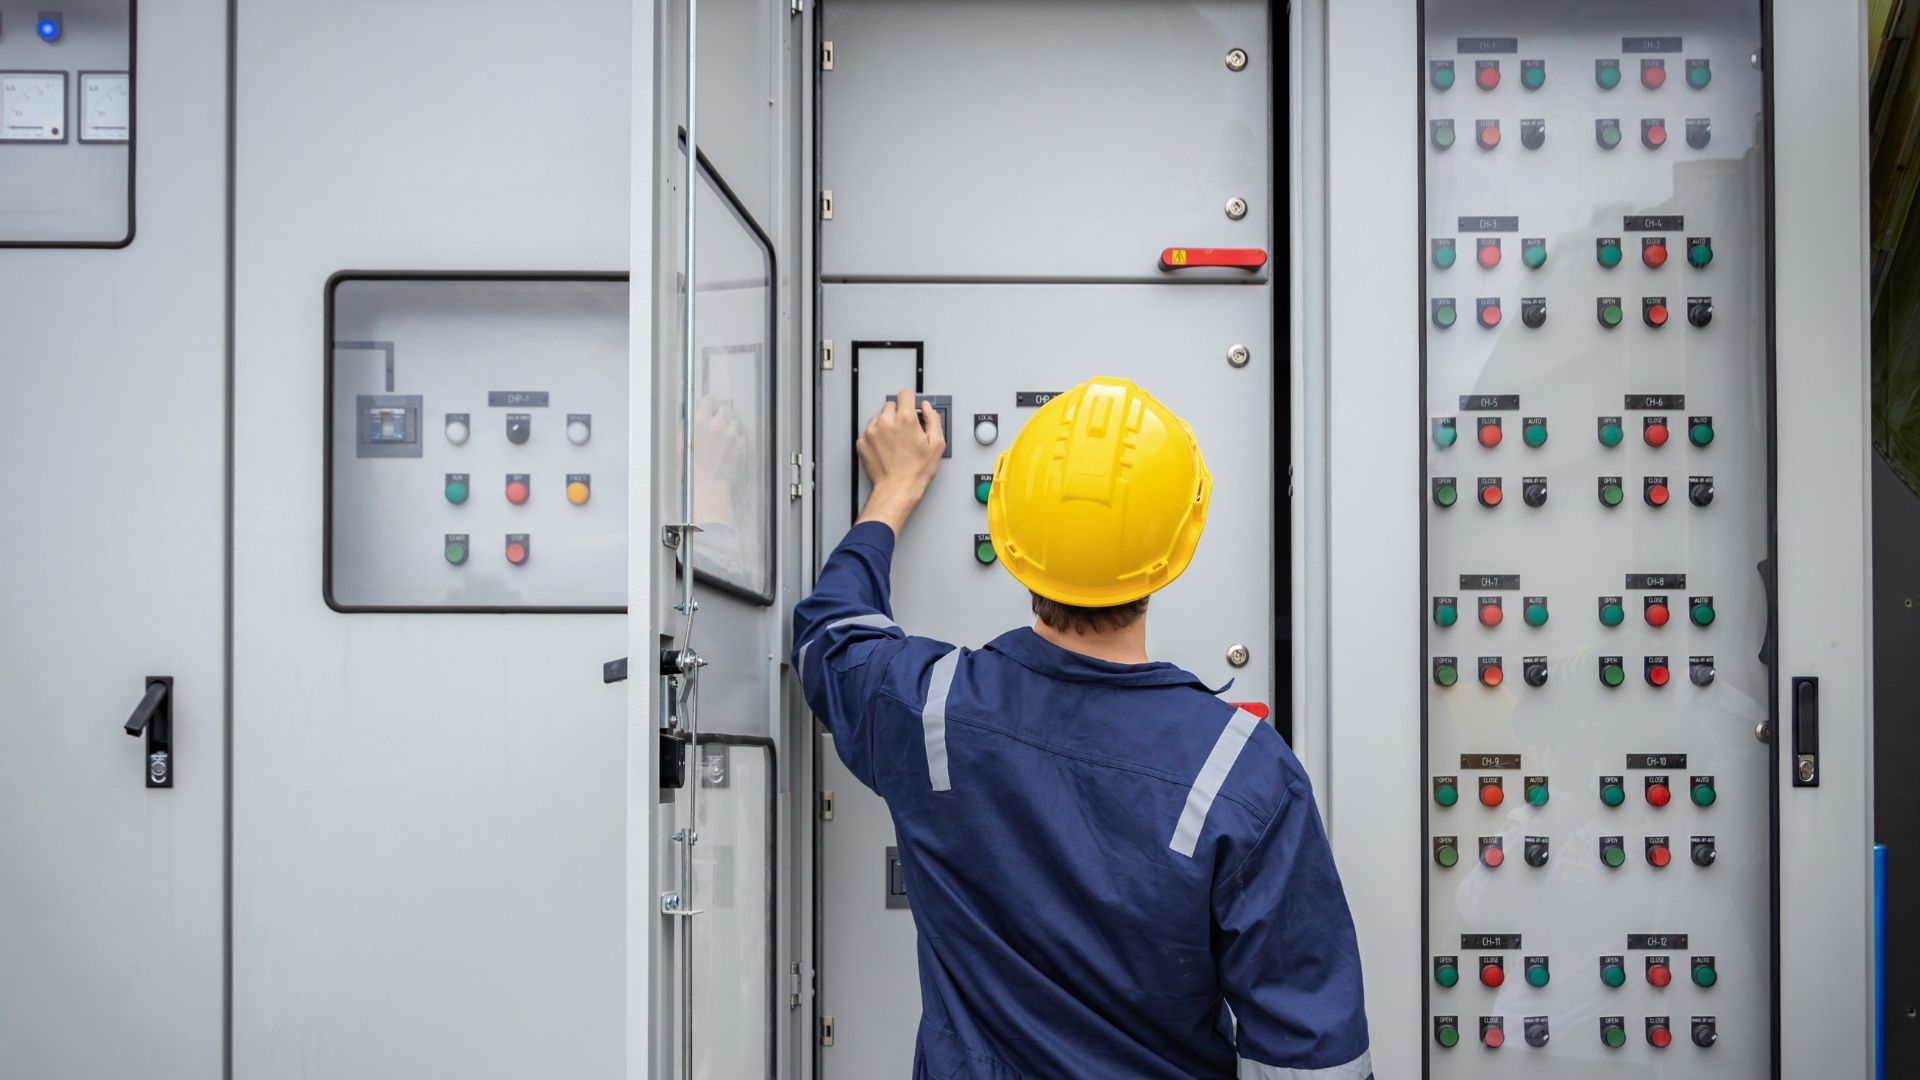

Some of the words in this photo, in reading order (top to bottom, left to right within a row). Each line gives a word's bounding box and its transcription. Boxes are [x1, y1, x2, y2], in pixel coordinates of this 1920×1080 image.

[1479, 41, 1496, 49] CH-1
[1479, 219, 1496, 227] CH-3
[1644, 219, 1662, 227] CH-4
[507, 394, 530, 403] CHP-1
[1480, 398, 1497, 406] CH-5
[1645, 398, 1663, 406] CH-6
[1481, 578, 1498, 586] CH-7
[1646, 577, 1664, 586] CH-8
[1481, 757, 1499, 765] CH-9
[1646, 757, 1666, 765] CH-10
[1482, 937, 1500, 946] CH-11
[1647, 938, 1667, 946] CH-12
